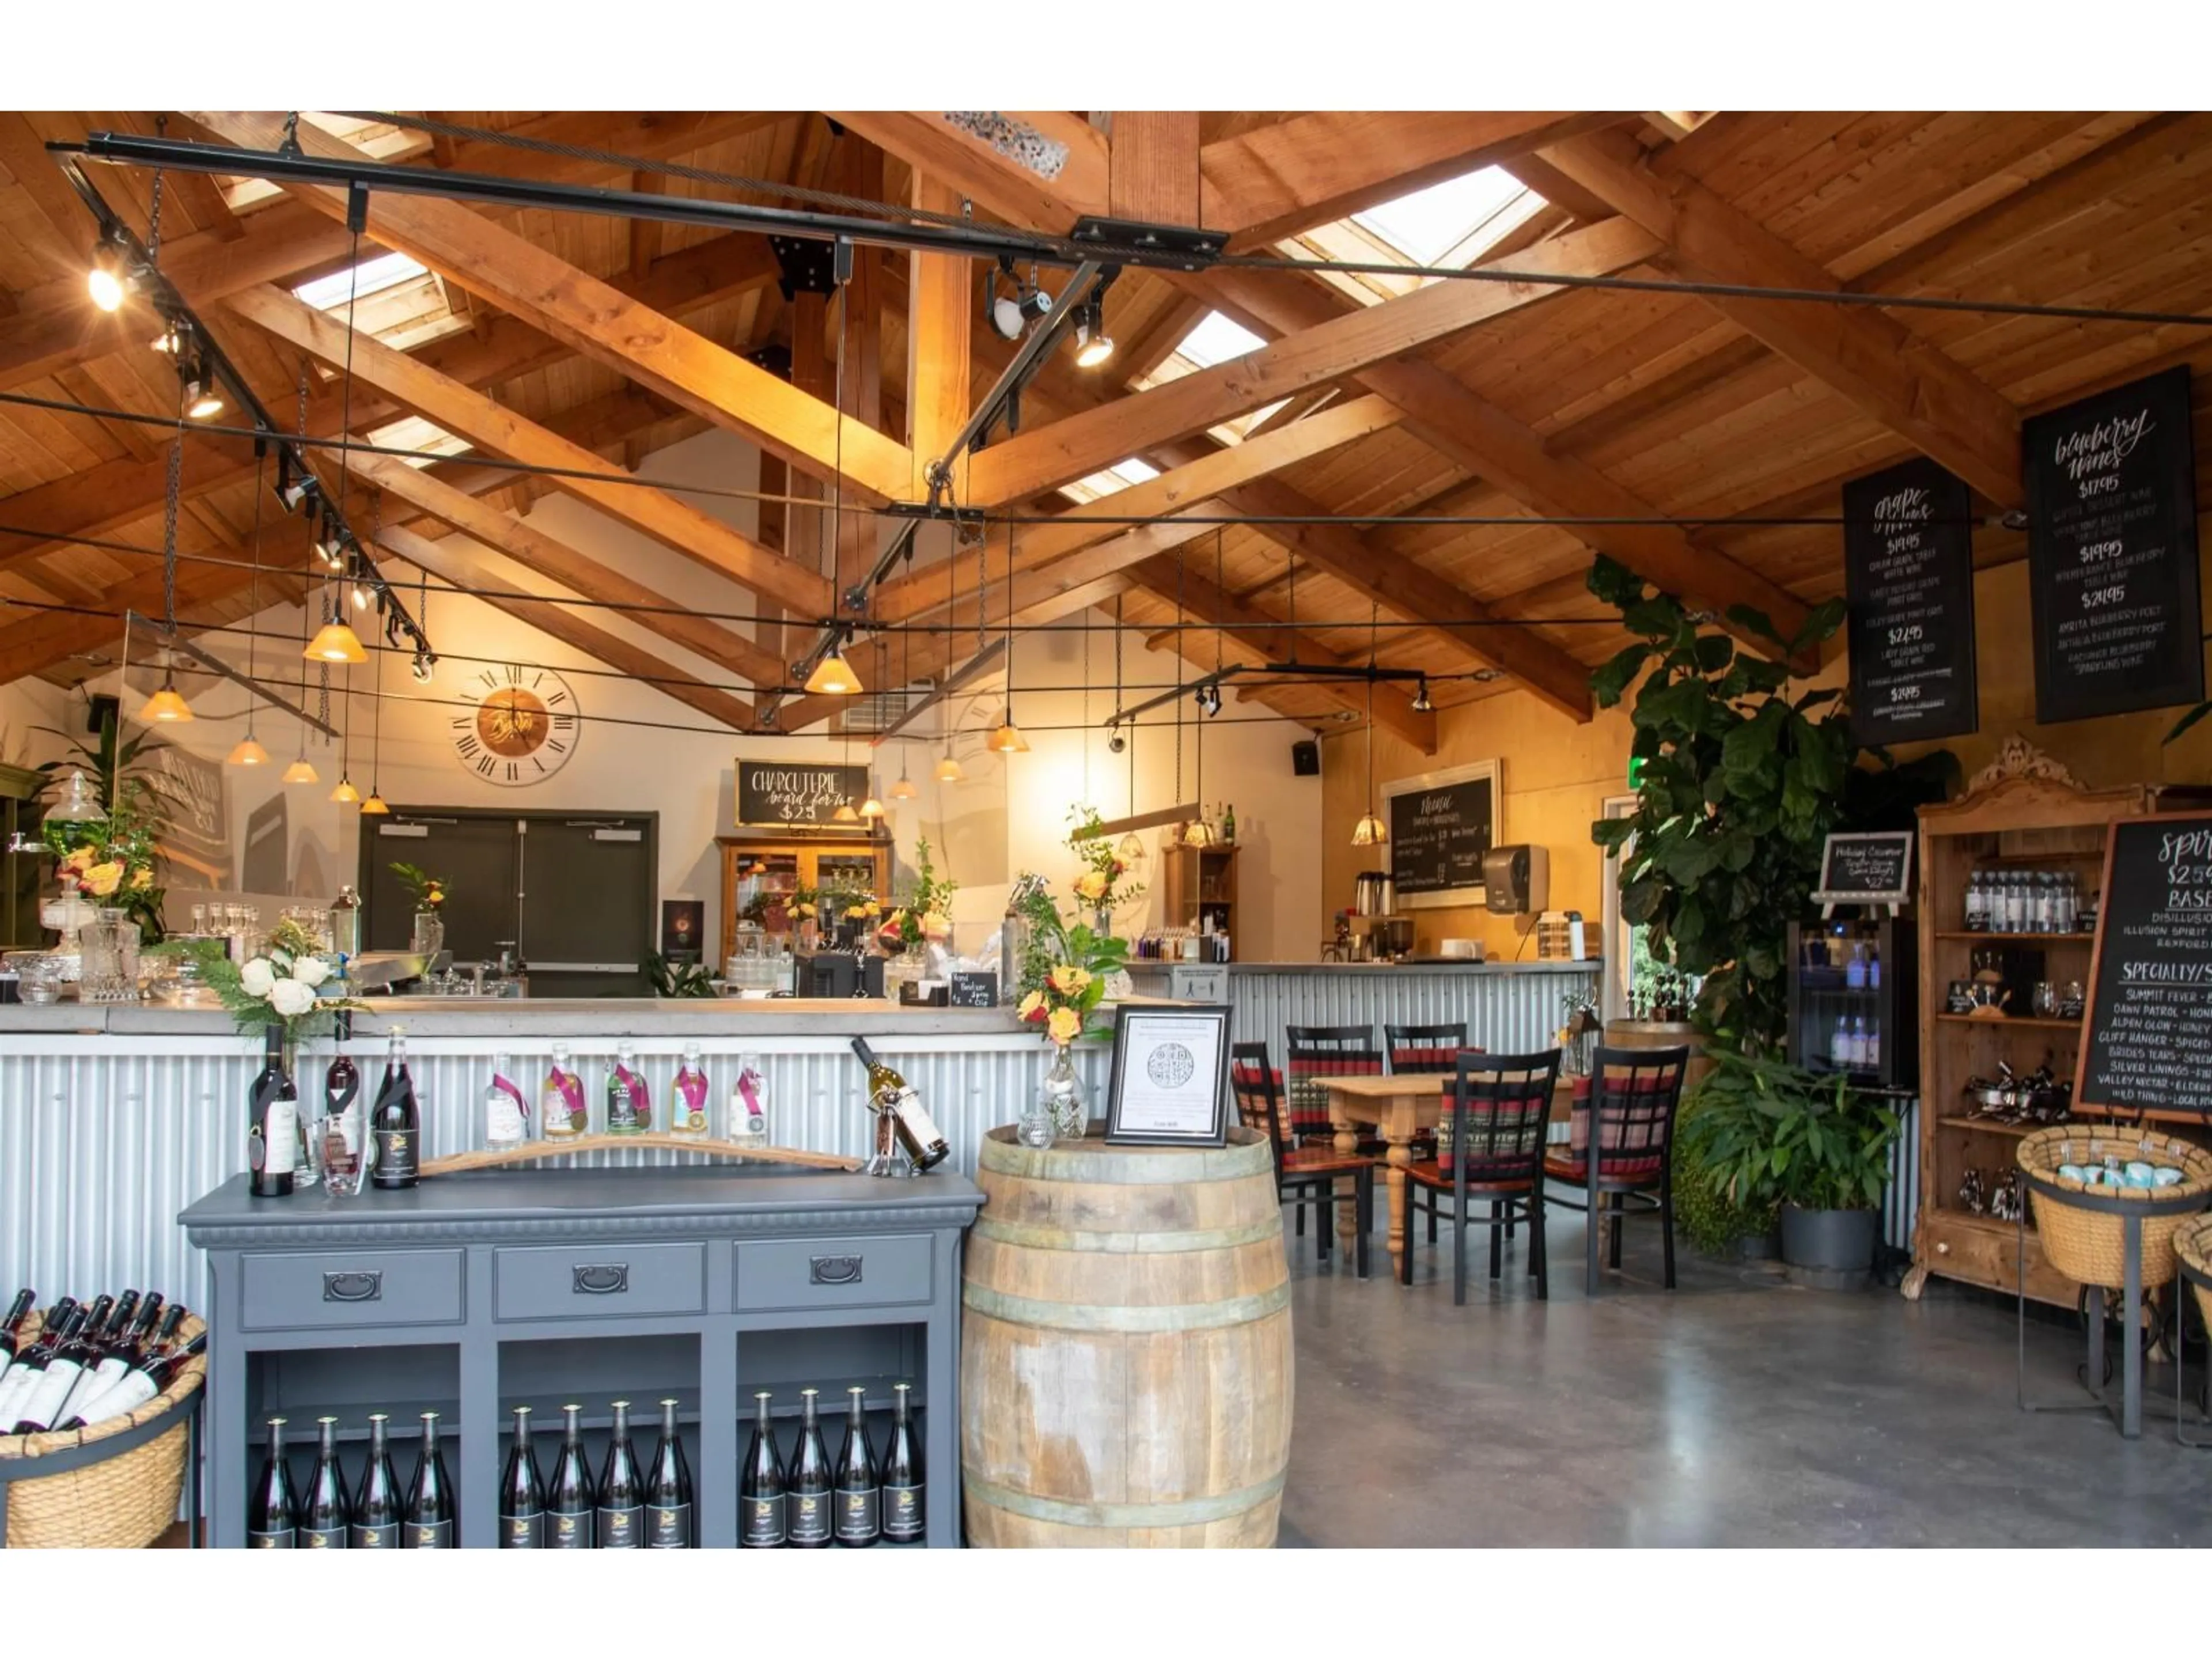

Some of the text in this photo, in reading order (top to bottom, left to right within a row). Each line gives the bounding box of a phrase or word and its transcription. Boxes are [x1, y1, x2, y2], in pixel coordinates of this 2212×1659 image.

[2055, 408, 2157, 465] blueberry
[2078, 474, 2120, 499] $17.95
[751, 770, 839, 795] CHARCUTERIE
[779, 806, 816, 820] $25
[2123, 925, 2206, 937] ILLUSION SPIRIT
[2126, 987, 2198, 1002] SUMMIT FEVER
[2113, 1002, 2140, 1014] DAWN
[2143, 1004, 2179, 1018] PATROL
[2111, 1017, 2211, 1035] ALPEN GLOW HONEY
[2098, 1030, 2211, 1050] CLIFF HANGER SPICED
[2108, 1046, 2146, 1058] BRIDES
[2149, 1049, 2176, 1061] TEARS
[2109, 1061, 2146, 1074] SILVER
[2149, 1063, 2189, 1077] LININGS
[2096, 1073, 2134, 1086] VALLEY
[2135, 1076, 2169, 1089] NECTAR
[2137, 1089, 2166, 1104] THING
[2173, 1093, 2198, 1107] LOCAL
